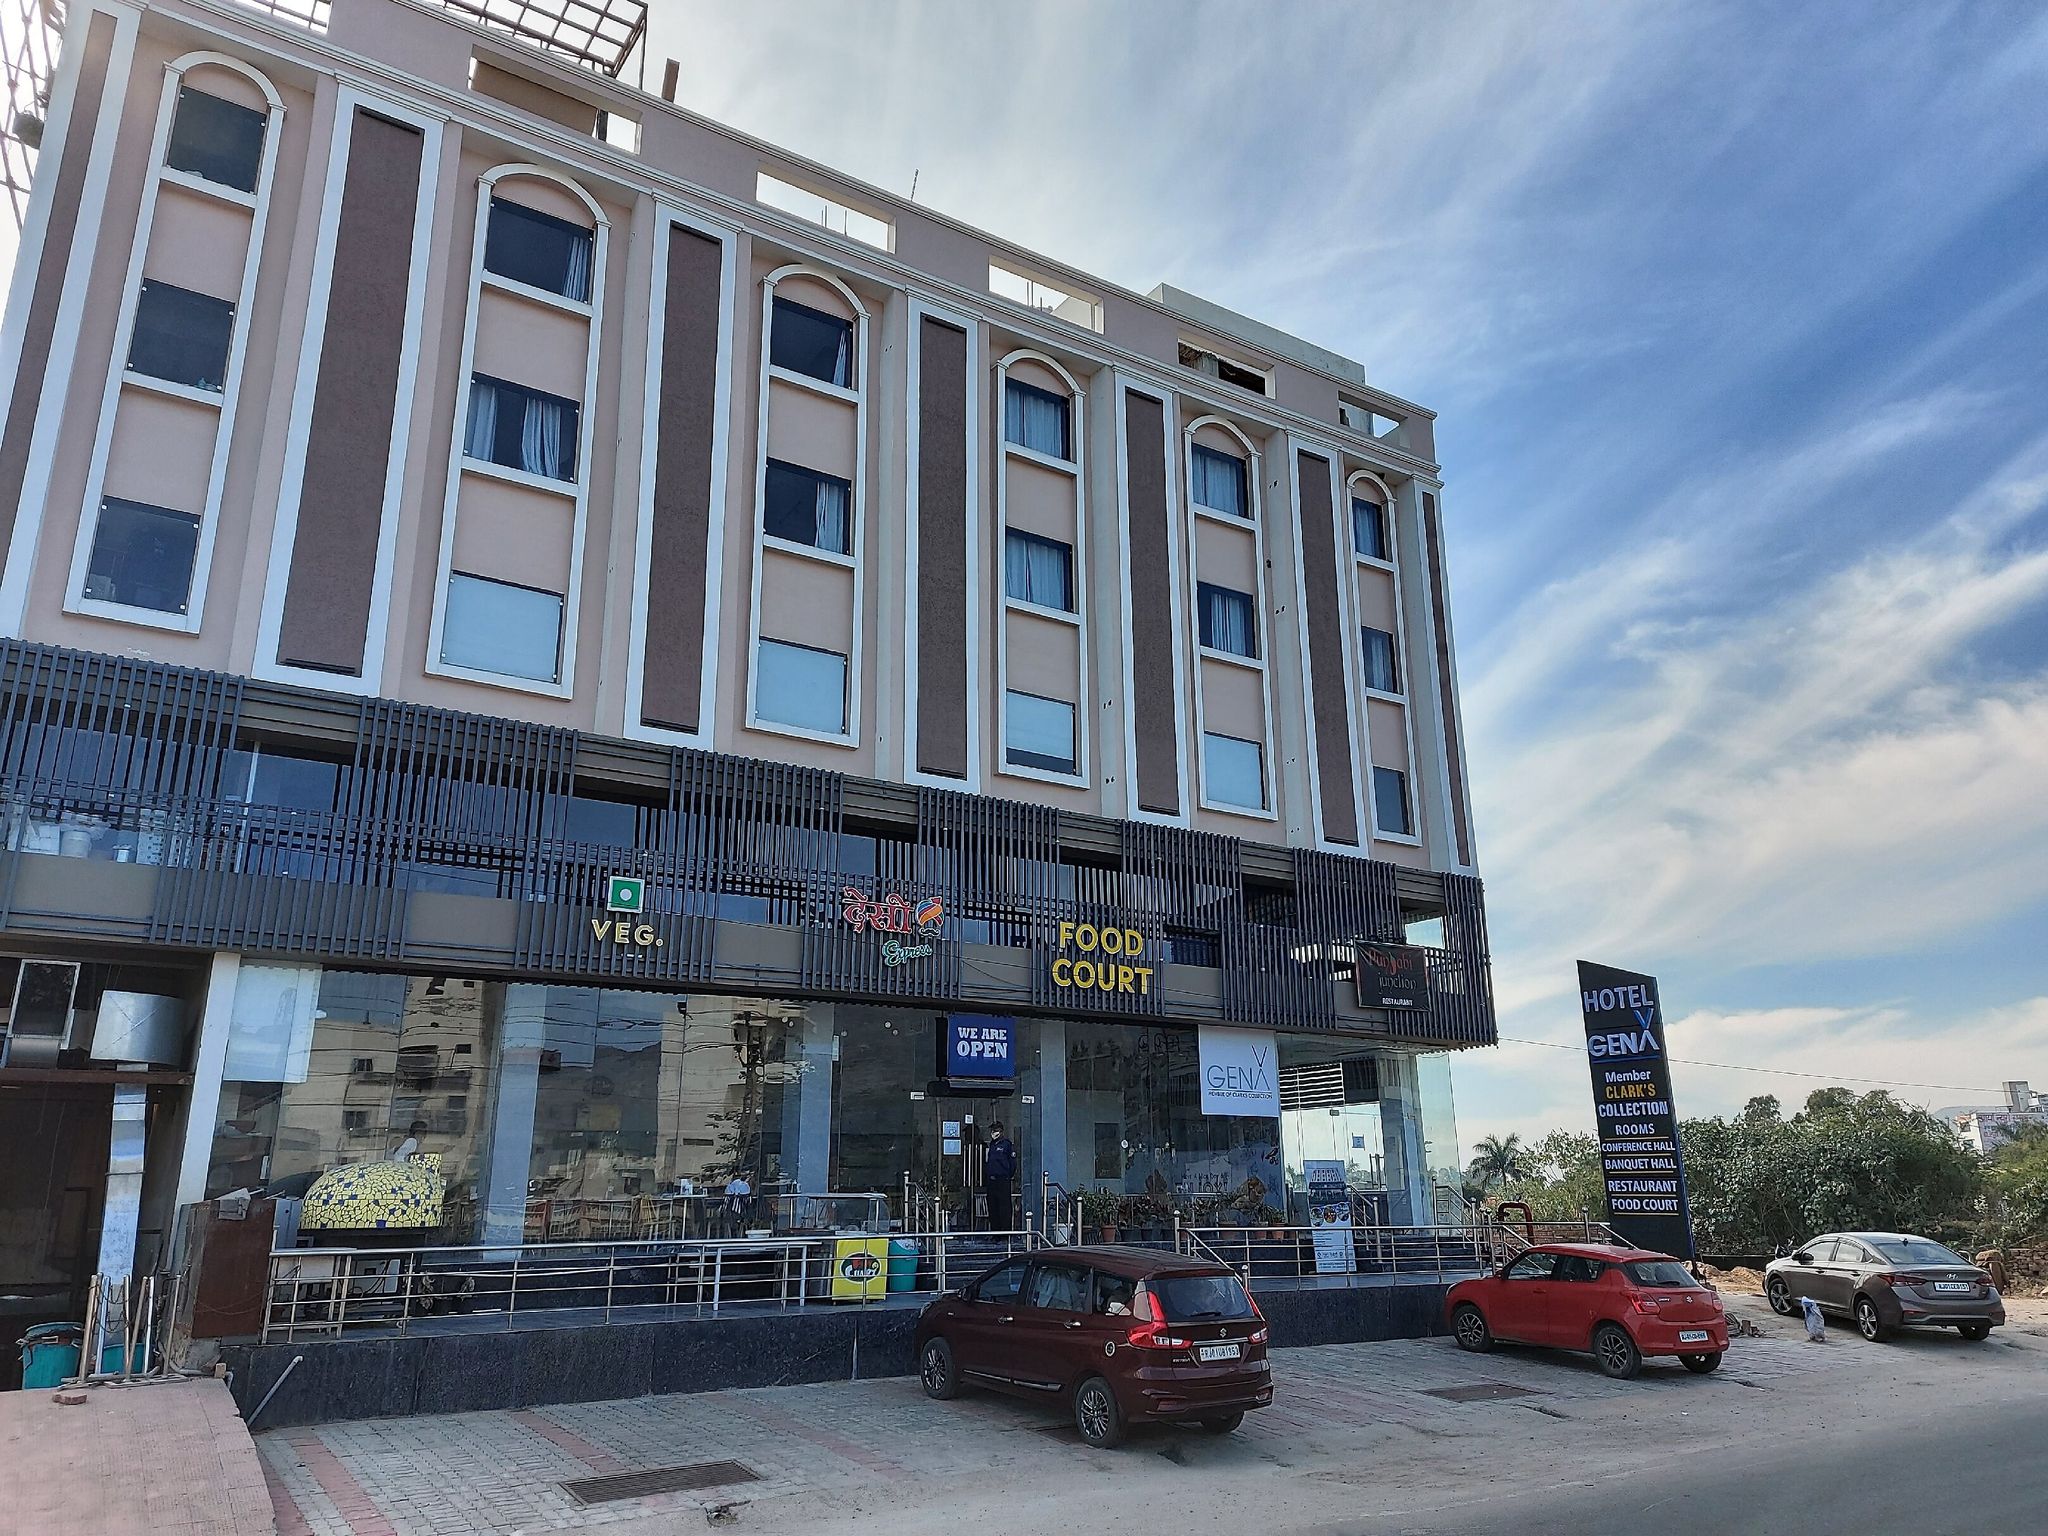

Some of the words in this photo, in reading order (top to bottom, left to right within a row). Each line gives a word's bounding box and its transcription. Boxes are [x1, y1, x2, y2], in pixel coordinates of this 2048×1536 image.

[591, 919, 663, 947] VEG.
[1059, 921, 1143, 956] FOOD
[882, 940, 932, 966] Express
[1052, 958, 1153, 994] COURT
[1583, 984, 1654, 1012] HOTEL
[957, 1026, 978, 1039] WE
[981, 1028, 1007, 1040] ARE
[957, 1040, 1008, 1058] OPEN
[1605, 1070, 1651, 1083] Member
[1605, 1083, 1657, 1099] CLARK'S
[1598, 1101, 1669, 1118] COLLECTION
[1615, 1123, 1655, 1136] ROOMS
[1601, 1142, 1653, 1152] CONFERENCE
[1653, 1141, 1676, 1151] HALL
[1605, 1158, 1649, 1171] BANQUET
[1650, 1158, 1677, 1169] HALL
[1608, 1180, 1677, 1192] RESTAURANT
[1611, 1198, 1641, 1211] FOOD
[1642, 1198, 1679, 1211] COURT
